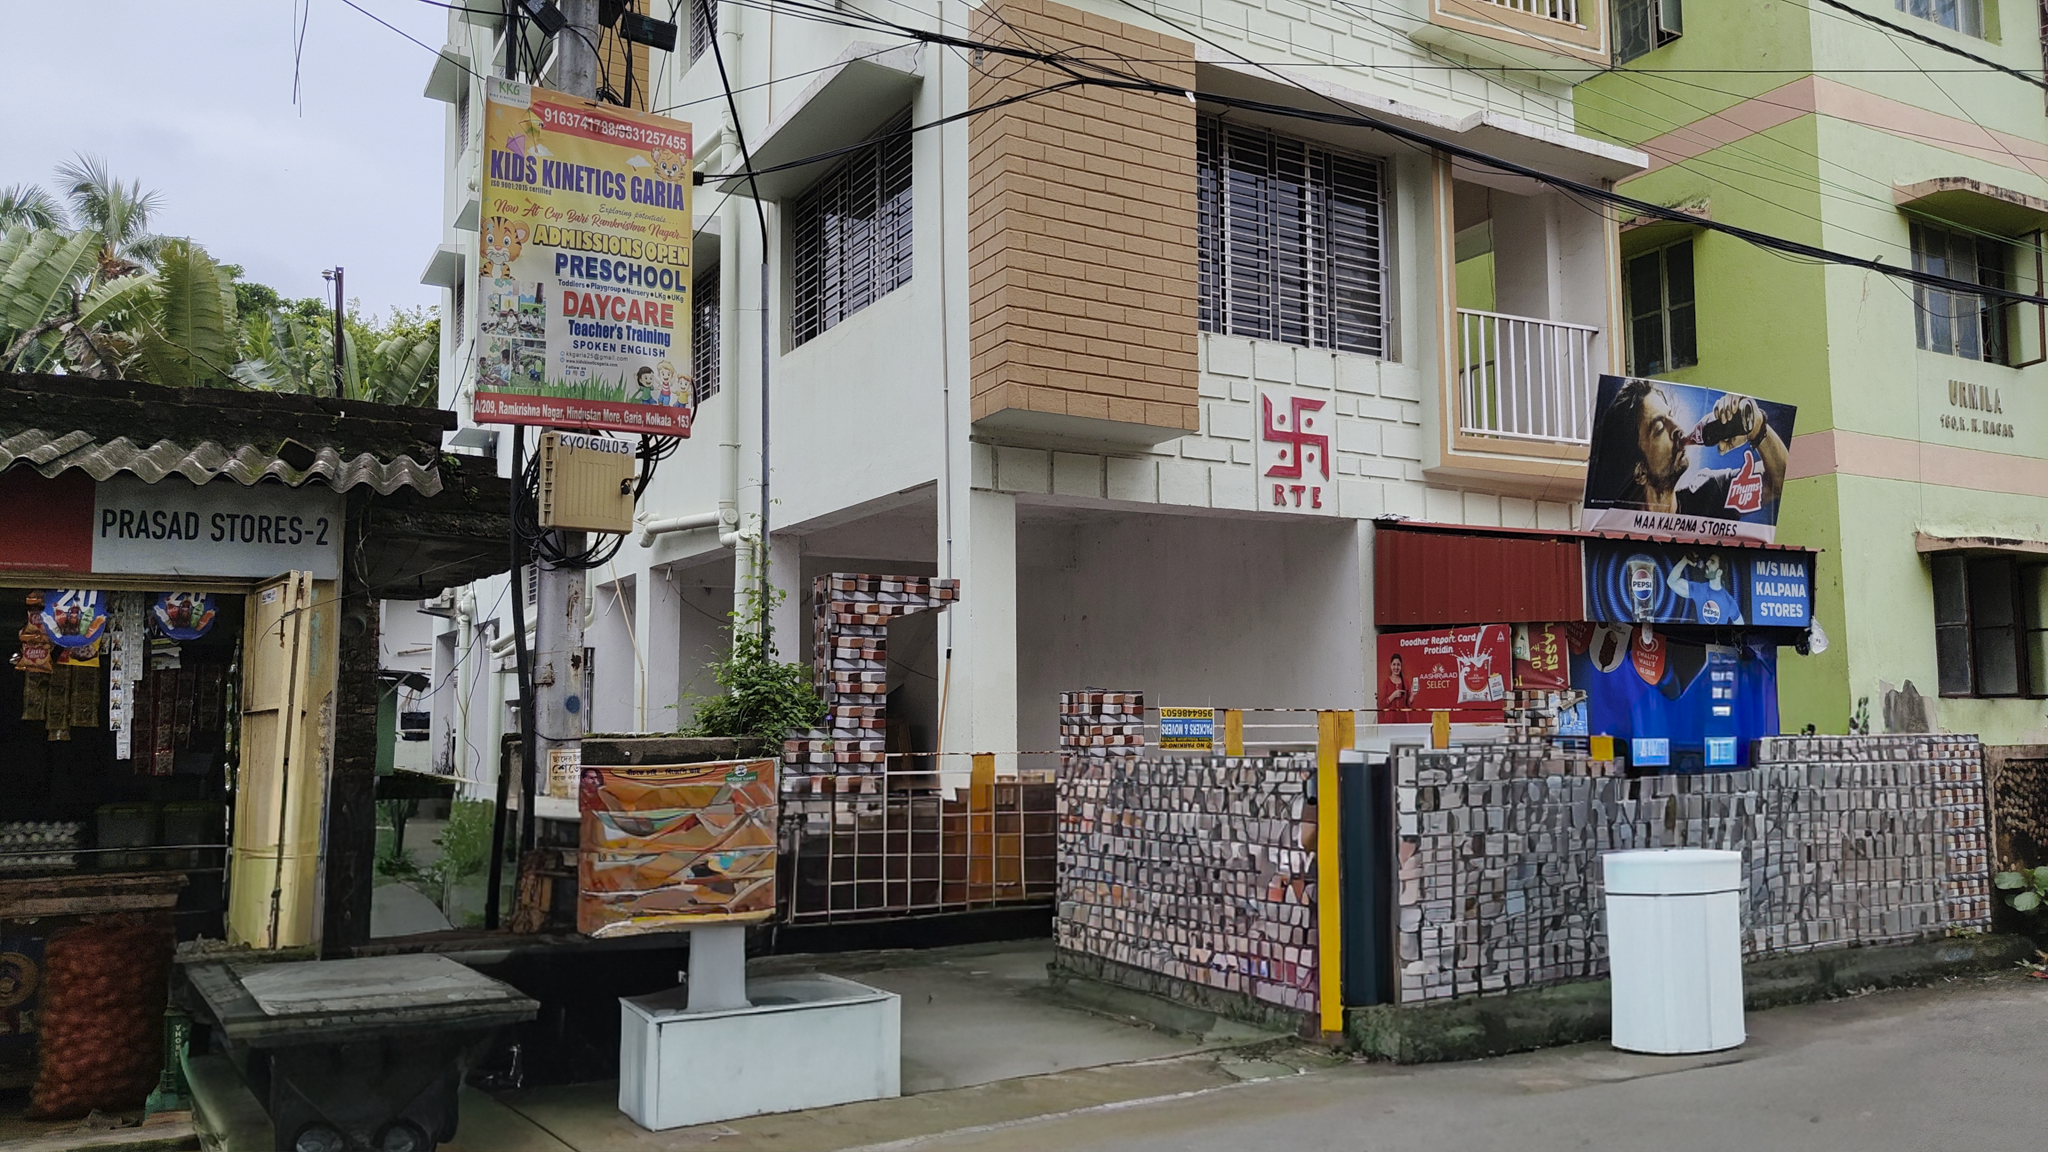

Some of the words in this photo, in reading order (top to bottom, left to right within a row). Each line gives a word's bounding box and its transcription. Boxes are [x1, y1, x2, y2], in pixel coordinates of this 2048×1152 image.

[499, 81, 520, 96] KKG
[491, 150, 537, 185] KIDS
[542, 159, 626, 201] KINETICS
[630, 176, 684, 211] GARIA
[501, 182, 528, 191] 9001:2015
[599, 203, 632, 218] Exploring
[494, 199, 519, 214] Now
[521, 203, 543, 217] At
[544, 207, 563, 221] Cup
[567, 209, 590, 224] Bari
[592, 214, 647, 233] Ramkrishna
[649, 223, 687, 242] Nagar
[533, 224, 643, 260] ADMISSIONS
[645, 241, 690, 267] OPEN
[555, 253, 687, 293] PRESCHOOL
[558, 279, 585, 289] Toddlers
[590, 282, 621, 294] Playgroup
[626, 287, 650, 298] Nursery
[563, 290, 674, 329] DAYCARE
[568, 319, 623, 341] Teacher's
[626, 325, 671, 348] Training
[573, 340, 616, 352] SPOKEN
[621, 344, 666, 358] ENGLISH
[1948, 379, 2003, 414] URMILA
[474, 399, 497, 416] A/209,
[499, 401, 541, 417] Ramkrishna
[542, 404, 565, 421] Nagar,
[567, 405, 601, 421] Hindustan
[602, 408, 622, 425] More,
[624, 410, 644, 427] Garia,
[646, 412, 672, 427] Kolkata
[677, 415, 690, 429] 153
[1731, 483, 1760, 499] Thums
[101, 509, 200, 540] PRASAD
[210, 513, 329, 546] STORES-2
[1633, 514, 1655, 529] MAA
[1657, 516, 1697, 533] KALPANA
[1699, 520, 1738, 537] STORES
[1756, 561, 1779, 577] M/S
[1780, 563, 1805, 578] MAA
[1633, 580, 1652, 589] PEPSI
[1755, 581, 1807, 598] KALPANA
[1703, 608, 1720, 616] PEPSI
[1760, 602, 1804, 618] STORES
[1400, 637, 1430, 647] Doodher
[1431, 635, 1457, 645] Report
[1457, 633, 1477, 642] Card
[1544, 622, 1559, 671] LASSI
[1424, 646, 1454, 655] Protidin
[1636, 651, 1659, 661] KWALITY
[1420, 672, 1458, 680] AASHIRVAAD
[1426, 680, 1450, 690] SELECT
[1161, 723, 1184, 735] MOVERS
[1189, 723, 1213, 735] PACKERS
